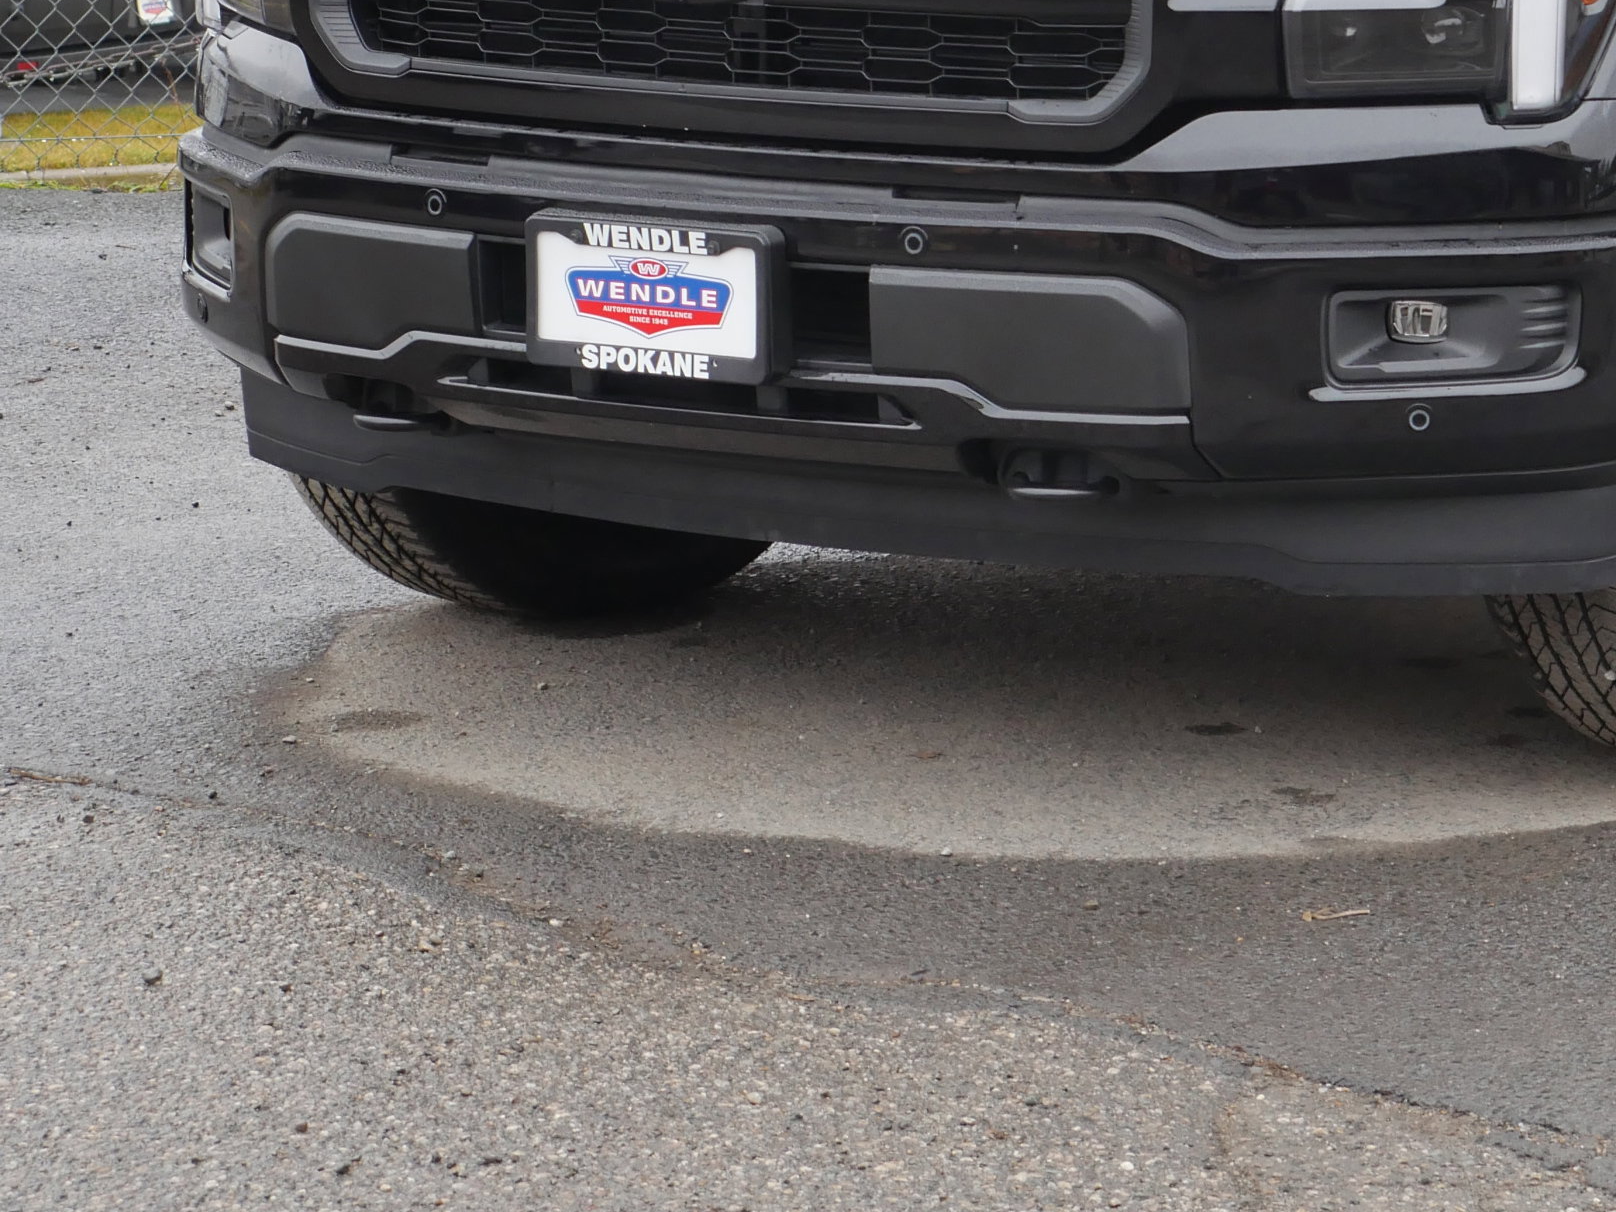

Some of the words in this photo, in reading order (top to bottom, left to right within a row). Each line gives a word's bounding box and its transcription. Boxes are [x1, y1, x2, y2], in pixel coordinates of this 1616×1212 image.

[583, 222, 709, 256] WENDLE
[576, 278, 718, 308] WENDLE
[603, 305, 648, 315] AUTOMOTIVE
[649, 309, 693, 319] EXCELLENCE
[629, 315, 651, 324] SINCE
[652, 317, 669, 325] 1943
[581, 344, 709, 379] SPOKANE
